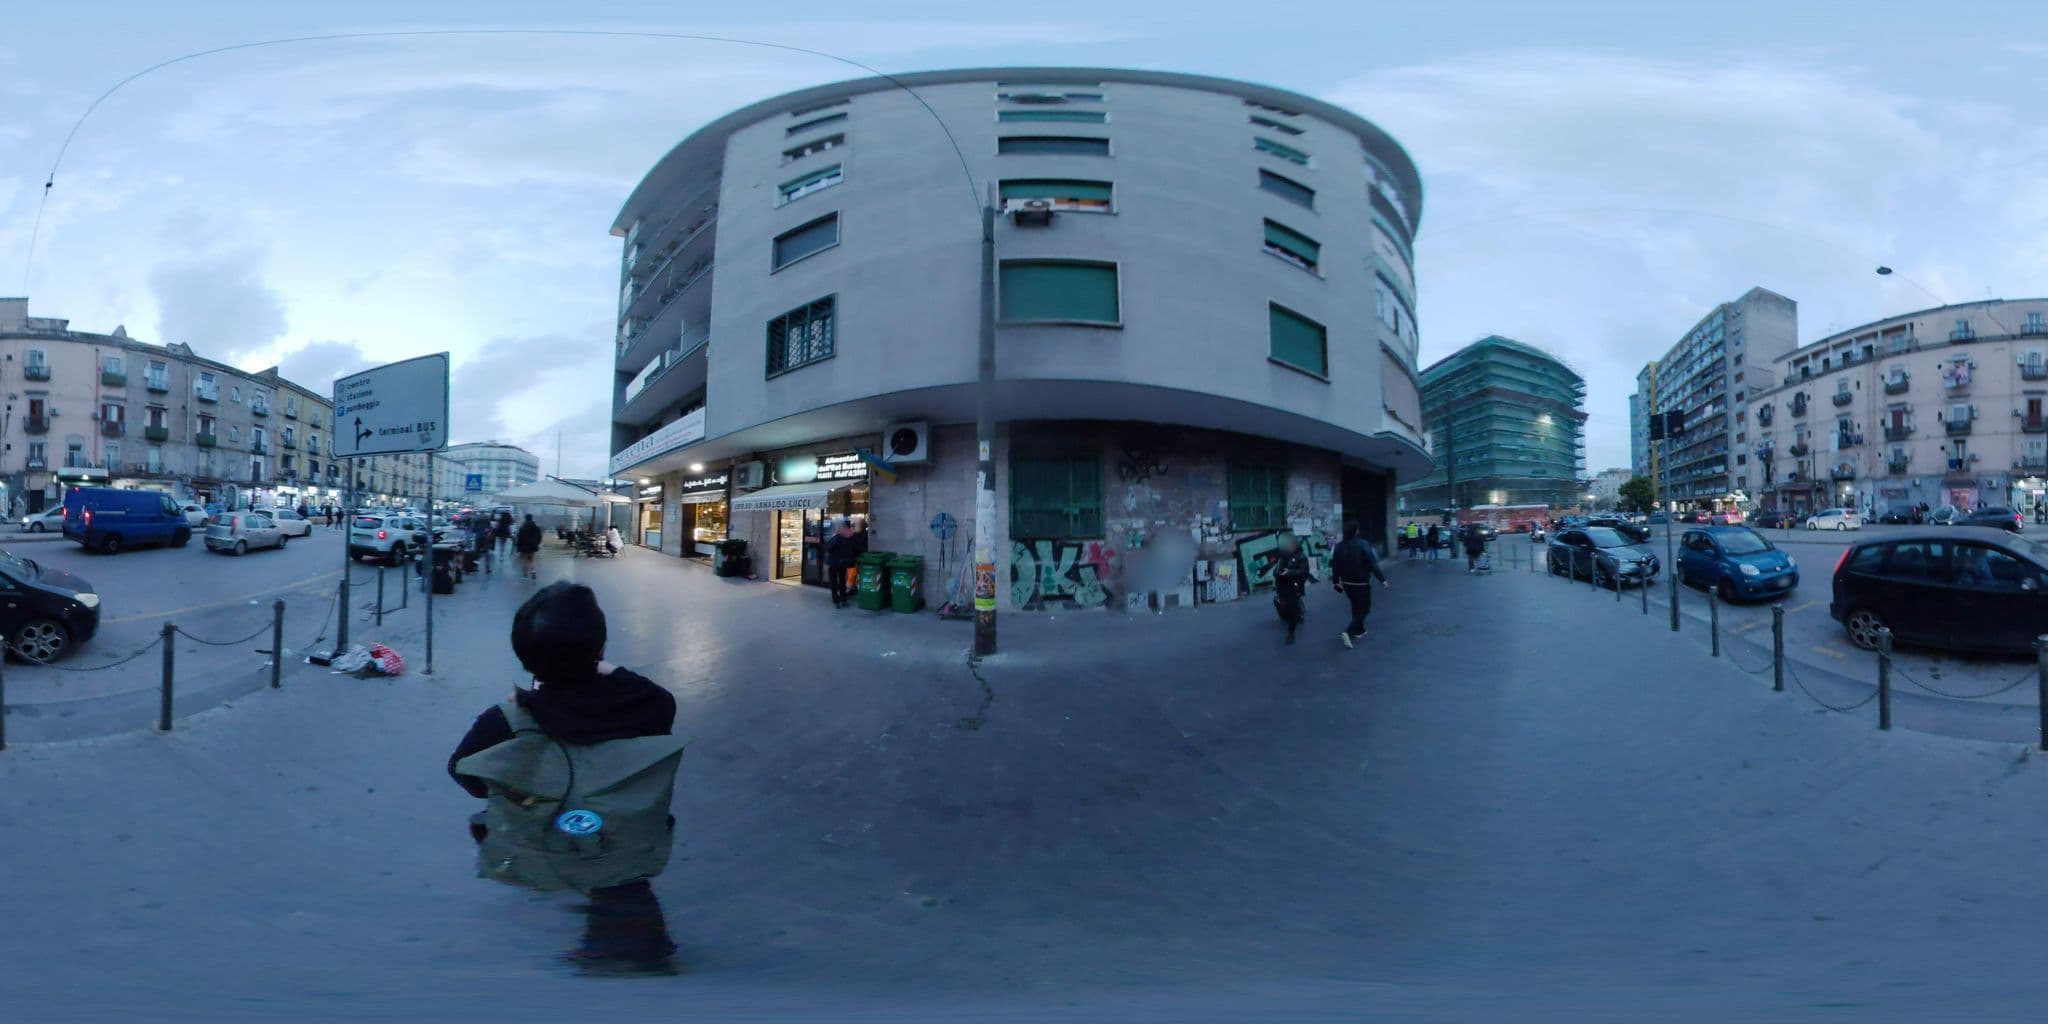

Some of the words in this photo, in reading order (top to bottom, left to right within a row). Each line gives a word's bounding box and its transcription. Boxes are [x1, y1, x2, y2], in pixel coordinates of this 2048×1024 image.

[379, 425, 413, 436] terminal
[417, 422, 435, 432] BUS
[754, 500, 786, 509] ARNALDO
[788, 499, 810, 508] LUCCI
